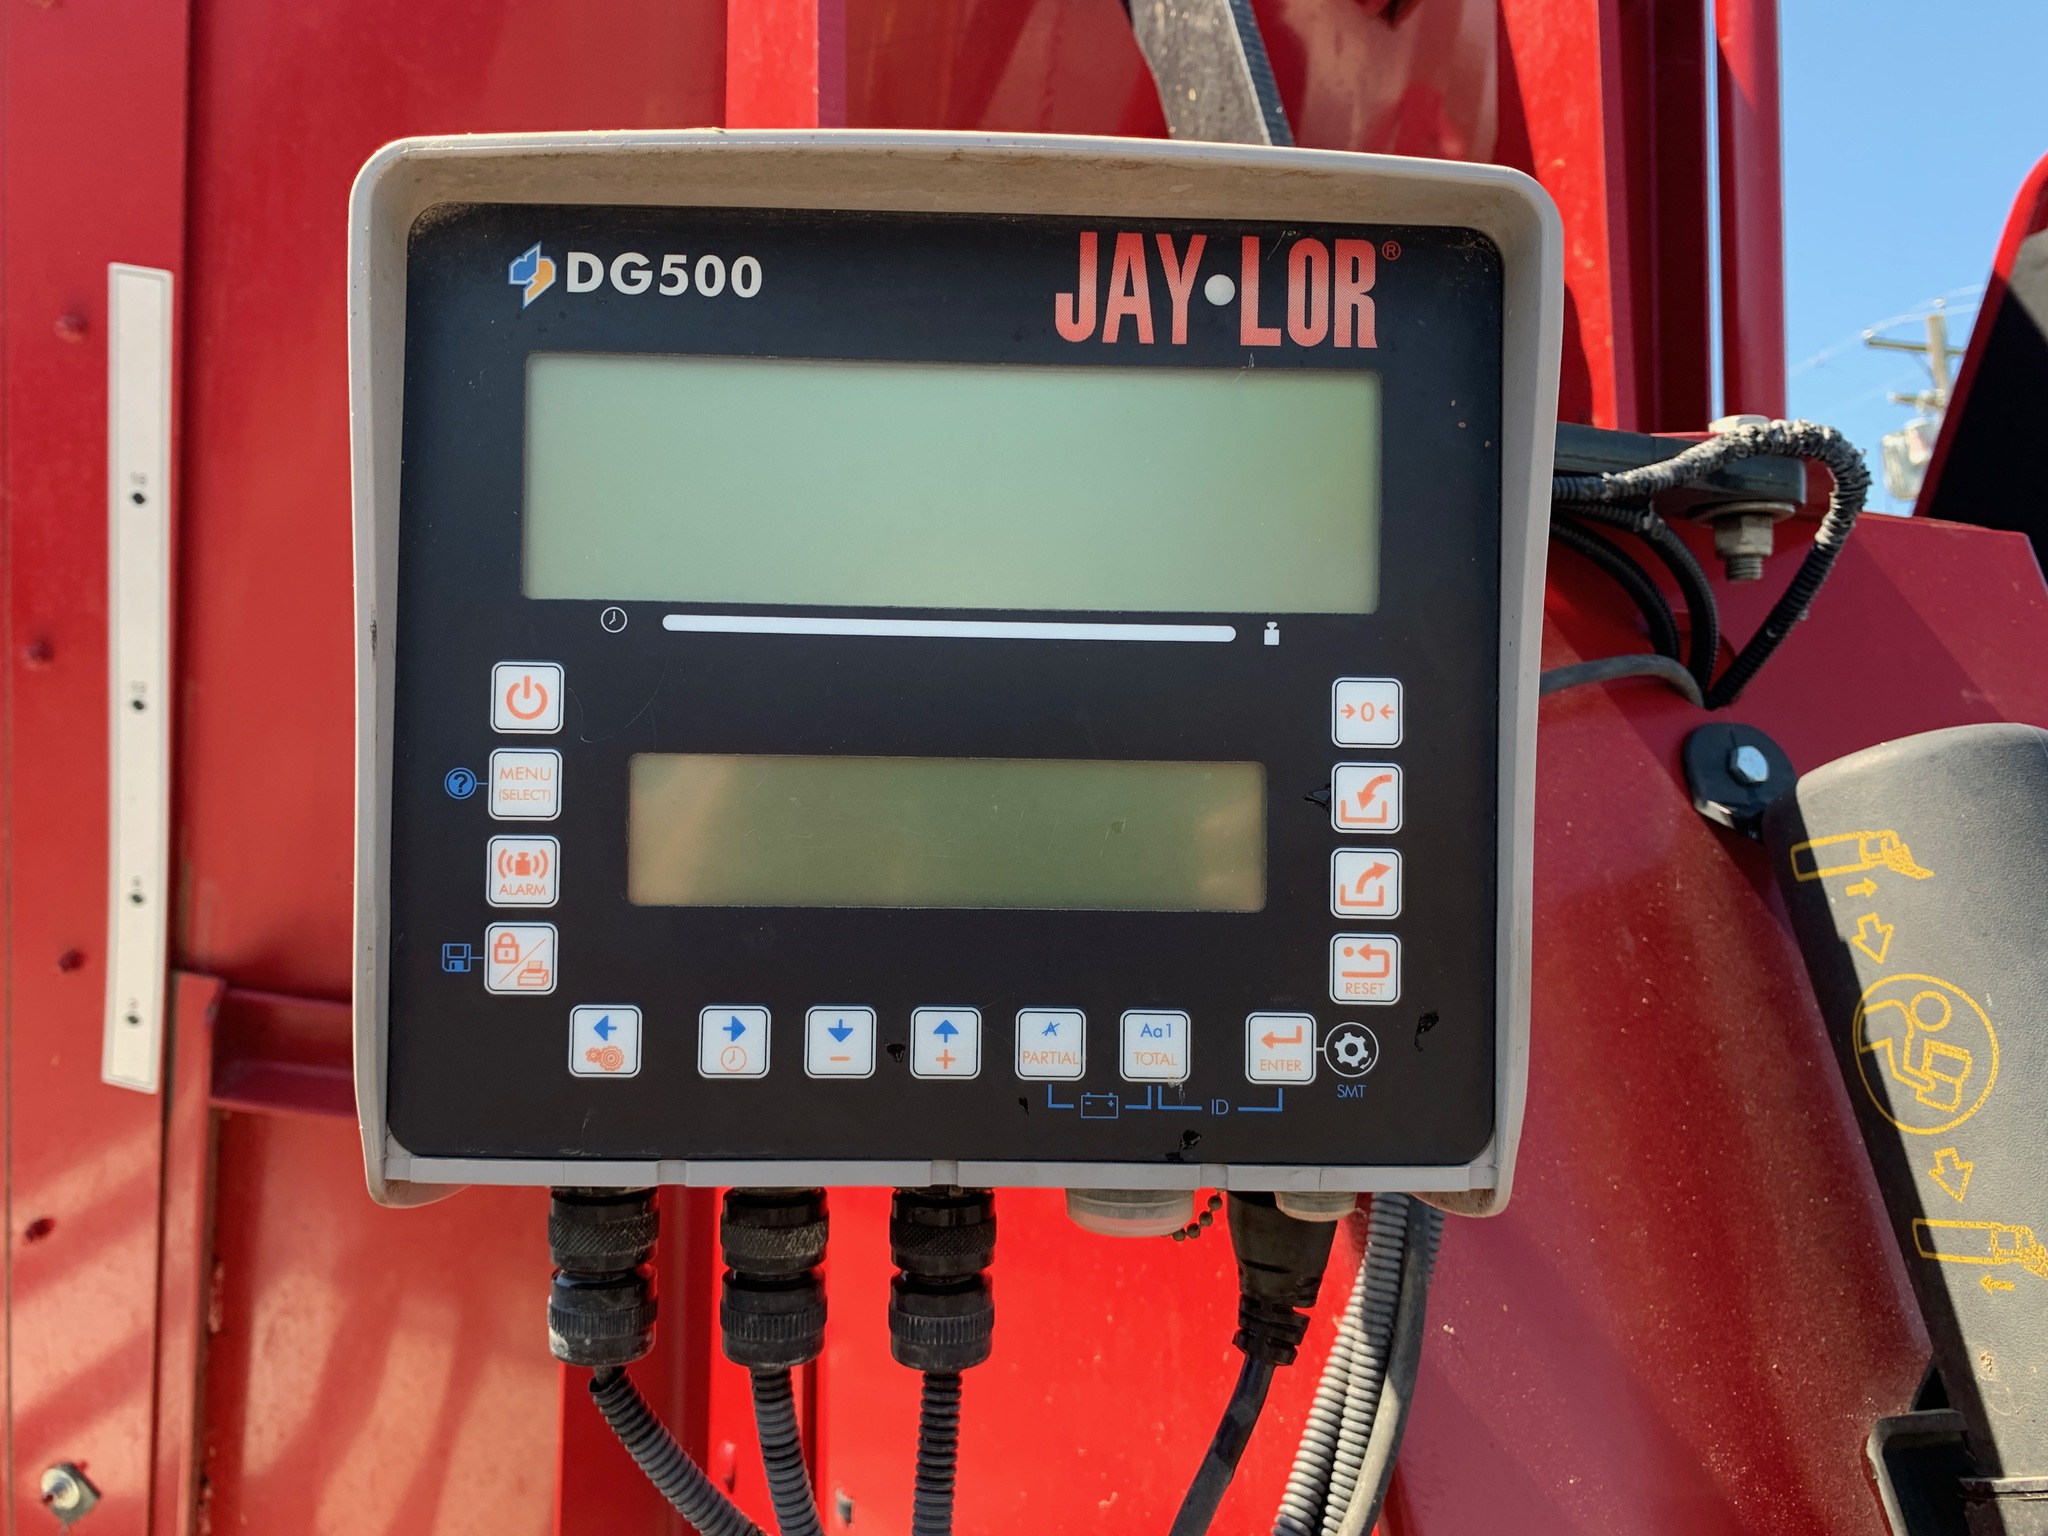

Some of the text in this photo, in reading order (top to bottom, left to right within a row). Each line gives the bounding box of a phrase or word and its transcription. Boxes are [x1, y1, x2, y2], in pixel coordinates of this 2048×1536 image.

[566, 251, 763, 298] DG500
[499, 766, 551, 781] MENU
[498, 788, 551, 803] (SELECT)
[499, 884, 546, 896] ALARM
[1345, 983, 1386, 995] RESET
[1140, 1023, 1172, 1038] Aa1
[1022, 1051, 1080, 1065] PARTIAL
[1133, 1052, 1178, 1066] TOTAL
[1260, 1059, 1302, 1072] ENTER
[1337, 1084, 1366, 1098] SMT
[1211, 1099, 1229, 1115] ID
